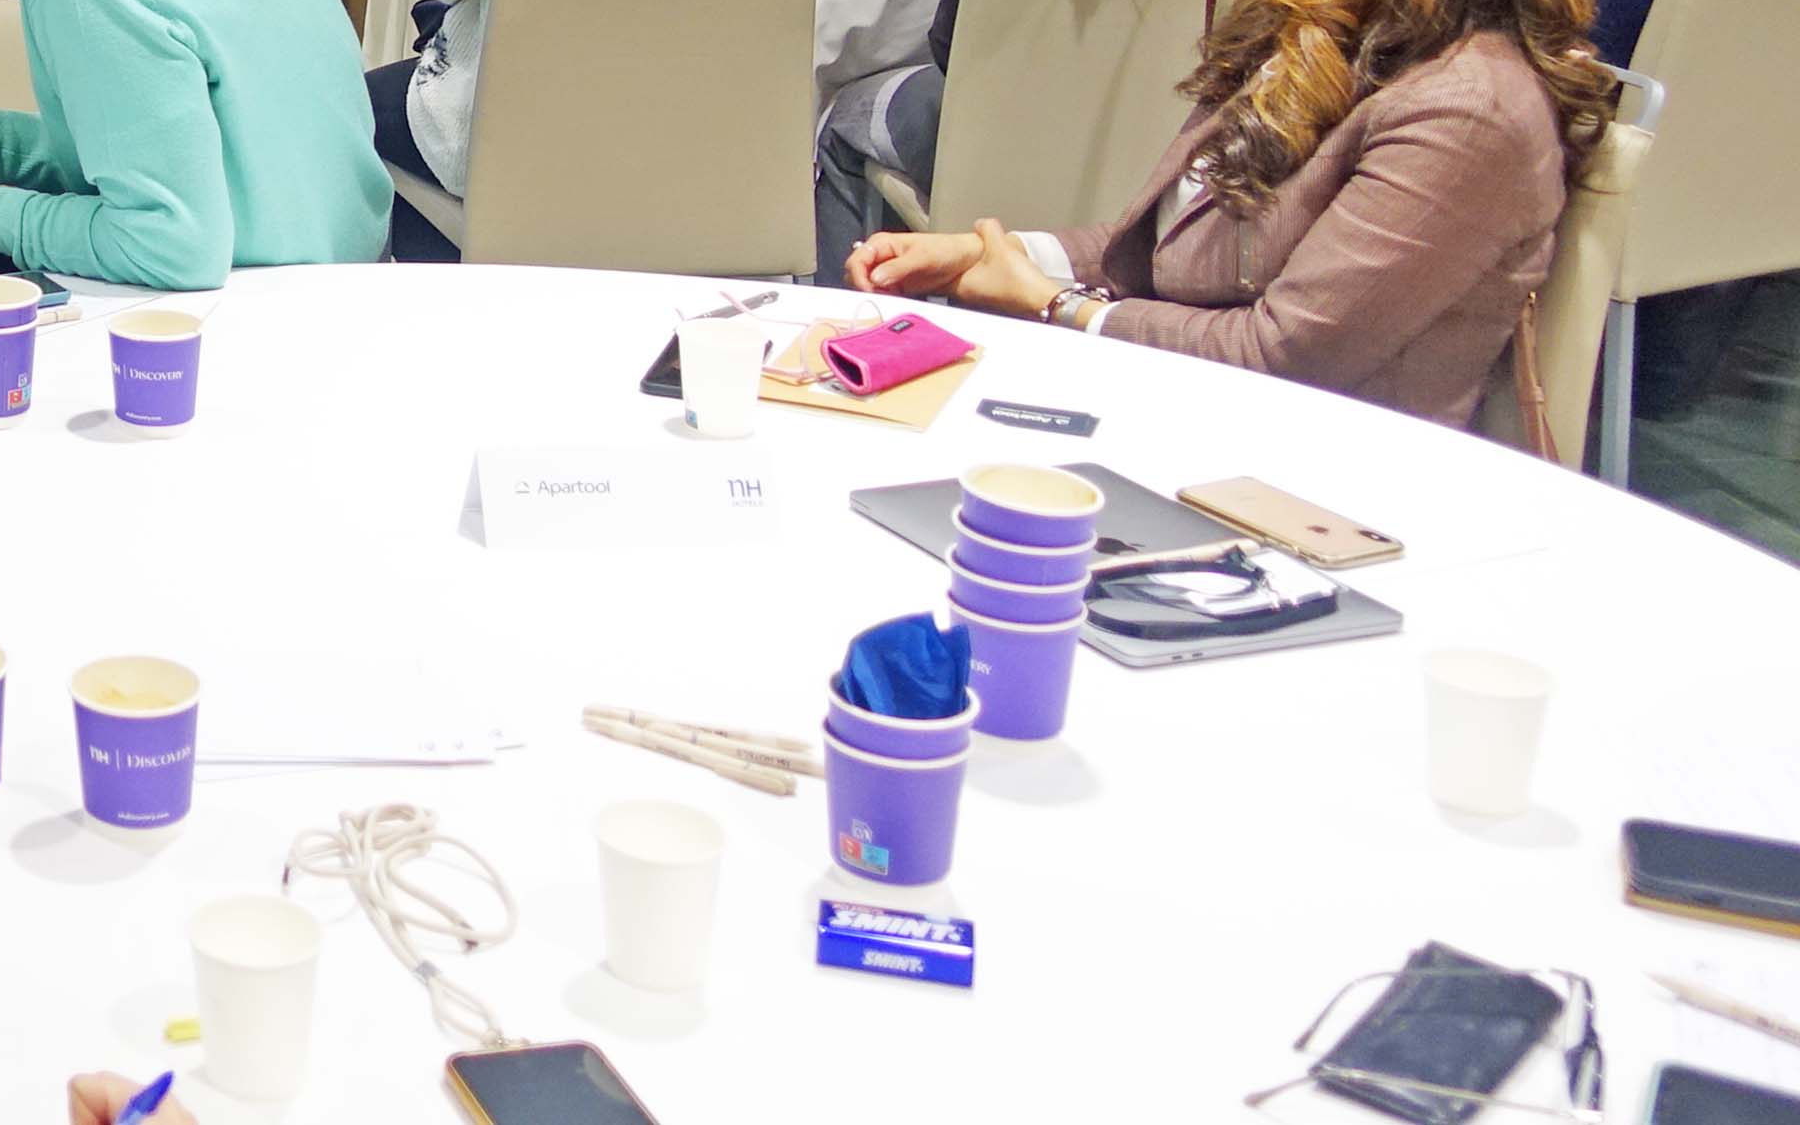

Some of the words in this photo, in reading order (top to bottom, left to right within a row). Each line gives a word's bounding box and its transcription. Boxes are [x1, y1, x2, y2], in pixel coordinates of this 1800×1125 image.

[130, 367, 184, 381] DISCOVERY
[538, 480, 610, 497] Apartool
[829, 909, 957, 941] SMINT
[862, 948, 922, 972] SMINT
